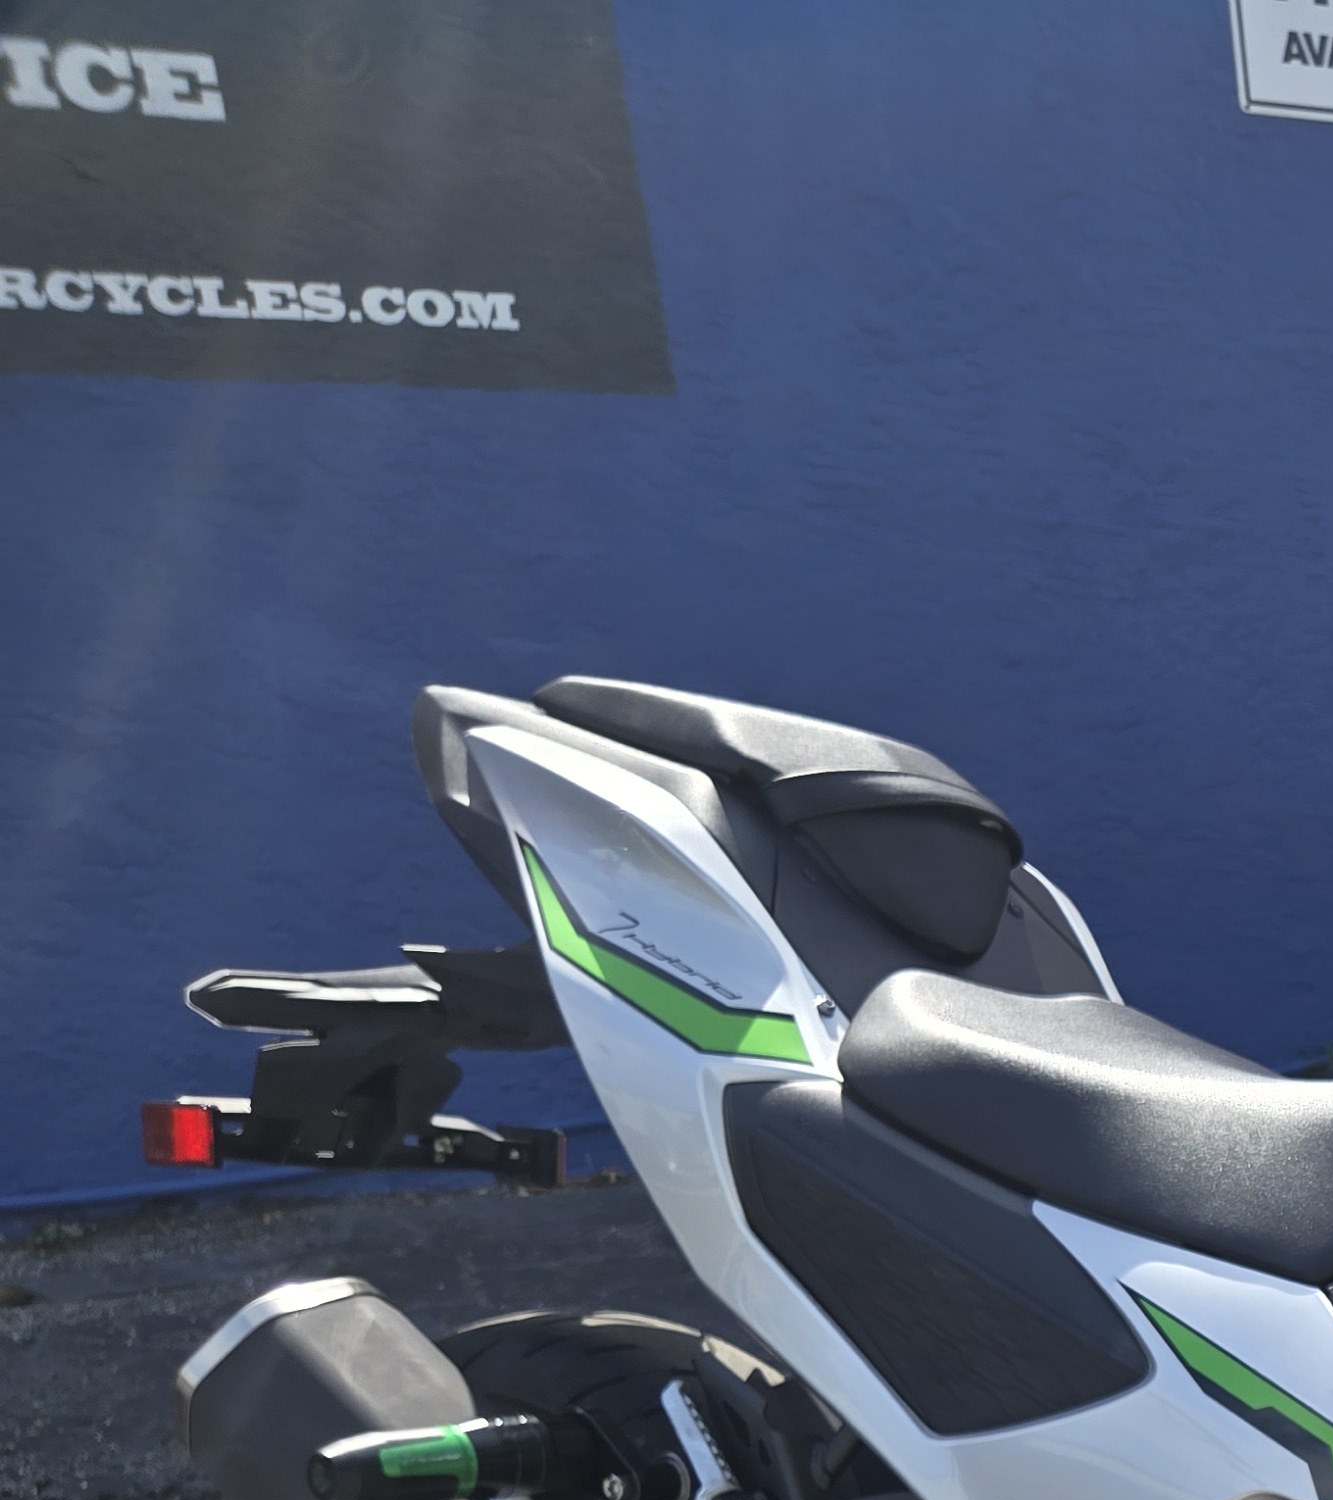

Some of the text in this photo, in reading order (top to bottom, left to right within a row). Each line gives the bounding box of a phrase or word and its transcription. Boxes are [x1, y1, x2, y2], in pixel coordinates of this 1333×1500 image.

[0, 35, 227, 122] ICE
[0, 267, 520, 331] RCYCLES.COM
[623, 932, 743, 1000] Hybrid
